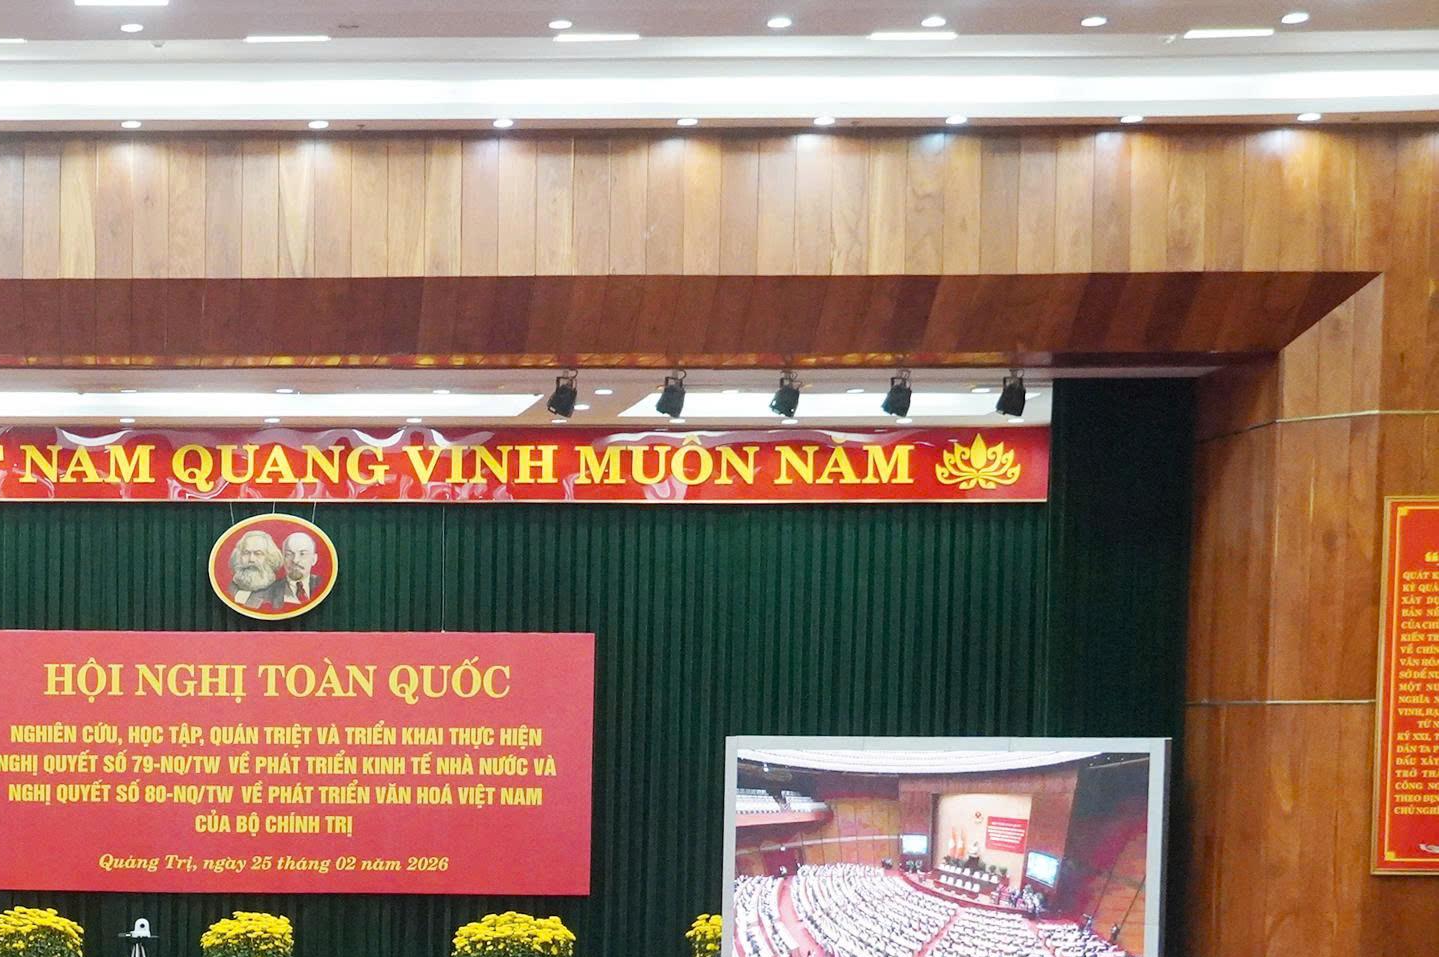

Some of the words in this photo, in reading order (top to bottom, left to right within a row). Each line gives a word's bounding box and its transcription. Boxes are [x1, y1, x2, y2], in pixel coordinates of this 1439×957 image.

[20, 444, 155, 484] NAM
[172, 444, 390, 492] QUANG
[402, 444, 558, 485] VINH
[574, 435, 760, 486] MUÔN
[774, 436, 915, 486] NĂM
[43, 657, 123, 703] HỘI
[135, 664, 246, 704] NGHỊ
[258, 657, 377, 698] TOÀN
[389, 656, 511, 705] QUỐC
[10, 722, 77, 744] NGHIÊN
[82, 723, 123, 746] CỨU,
[128, 726, 164, 748] HỌC
[169, 723, 205, 748] TẬP,
[210, 723, 259, 746] QUÁN
[264, 724, 313, 748] TRIỆT
[317, 724, 341, 745] VÀ
[345, 720, 397, 746] TRIỂN
[401, 727, 444, 746] KHAI
[449, 726, 495, 749] THỰC
[500, 725, 543, 750] HIỆN
[43, 750, 99, 774] QUYẾT
[103, 750, 128, 773] SỐ
[131, 755, 221, 775] 79-NQ/TW
[228, 751, 250, 774] VỀ
[255, 753, 301, 774] PHÁT
[306, 750, 358, 775] TRIỂN
[362, 756, 406, 775] KINH
[411, 752, 433, 774] TẾ
[436, 754, 474, 775] NHÀ
[479, 754, 529, 776] NƯỚC
[533, 755, 557, 776] VÀ
[8, 784, 51, 805] NGHỊ
[56, 779, 112, 803] QUYẾT
[116, 779, 141, 803] SỐ
[144, 785, 234, 805] 80-NQ/TW
[241, 780, 263, 804] VỀ
[268, 783, 314, 804] PHÁT
[319, 779, 371, 804] TRIỂN
[375, 783, 411, 805] VĂN
[416, 784, 453, 805] HOÁ
[457, 784, 496, 808] VIỆT
[500, 787, 543, 806] NAM
[194, 809, 231, 833] CỦA
[236, 812, 260, 836] BỘ
[265, 812, 320, 833] CHÍNH
[324, 815, 353, 837] TRỊ
[98, 853, 160, 872] Quảng
[164, 854, 198, 873] Trị,
[202, 856, 247, 873] ngày
[250, 855, 273, 871] 25
[276, 855, 332, 874] tháng
[335, 856, 357, 871] 02
[360, 857, 402, 872] năm
[406, 856, 449, 872] 2026
